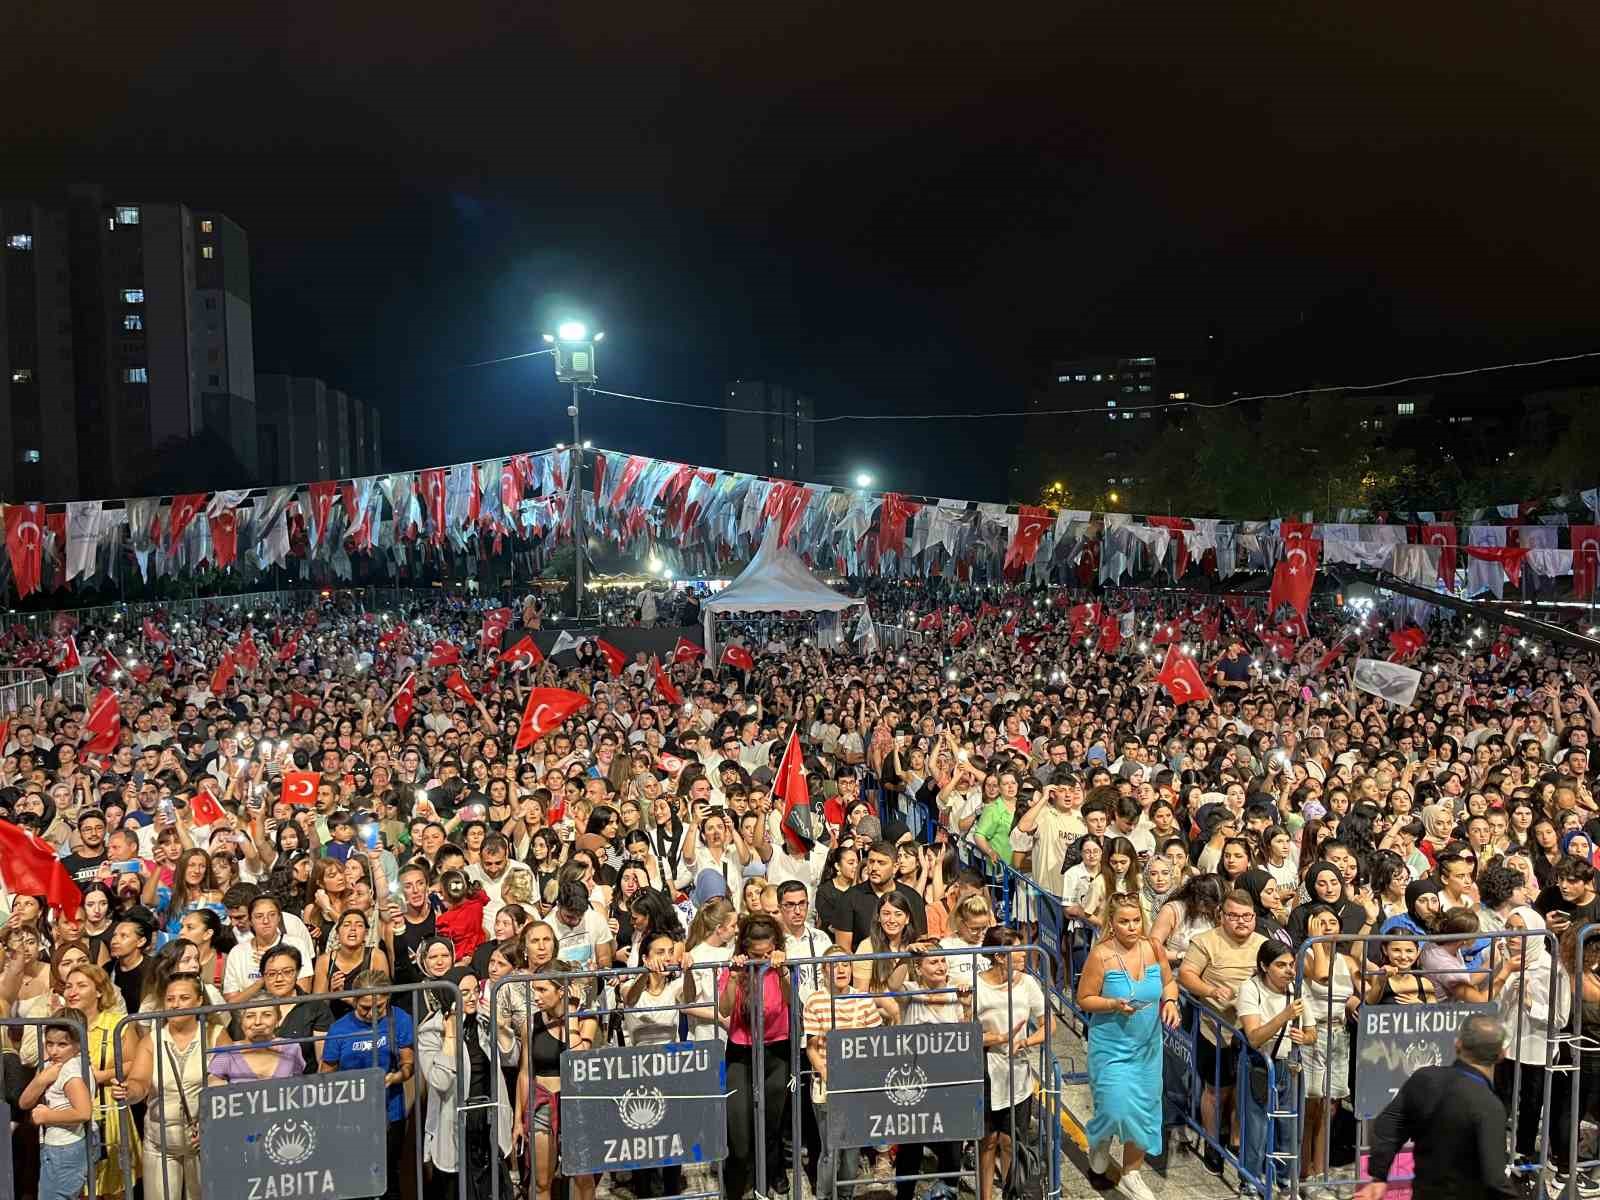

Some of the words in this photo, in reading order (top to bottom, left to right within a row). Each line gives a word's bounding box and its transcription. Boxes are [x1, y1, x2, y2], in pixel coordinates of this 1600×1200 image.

[841, 1031, 970, 1060] BEYLİKDÜZÜ
[573, 1049, 709, 1082] BEYLİKDÜZÜ
[211, 1078, 366, 1120] BEYLİKDÜZÜ
[870, 1111, 944, 1138] ZABITA
[604, 1133, 684, 1163] ZABITA
[247, 1169, 335, 1200] ZABITA
